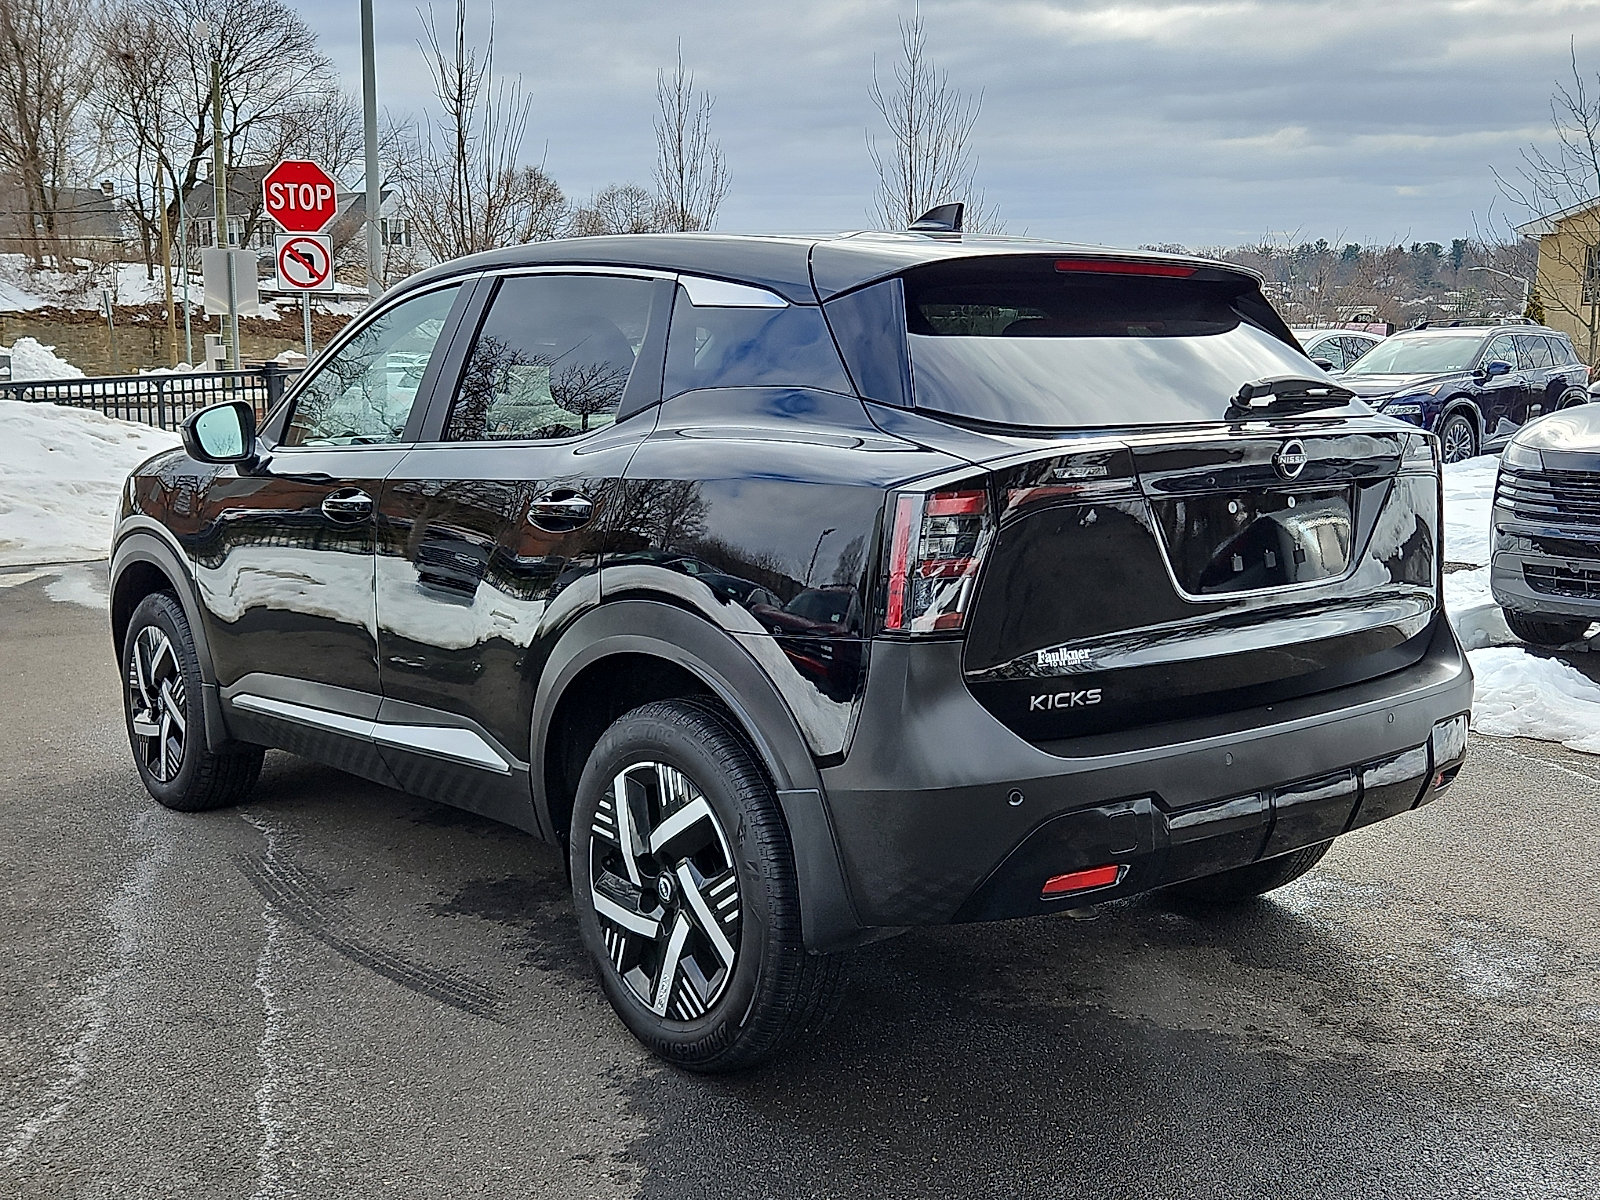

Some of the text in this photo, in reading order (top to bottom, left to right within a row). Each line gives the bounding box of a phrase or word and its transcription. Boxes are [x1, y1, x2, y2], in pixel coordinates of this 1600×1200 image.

[269, 182, 332, 211] STOP
[1037, 647, 1091, 664] Faulkner
[1029, 688, 1102, 711] KICKS
